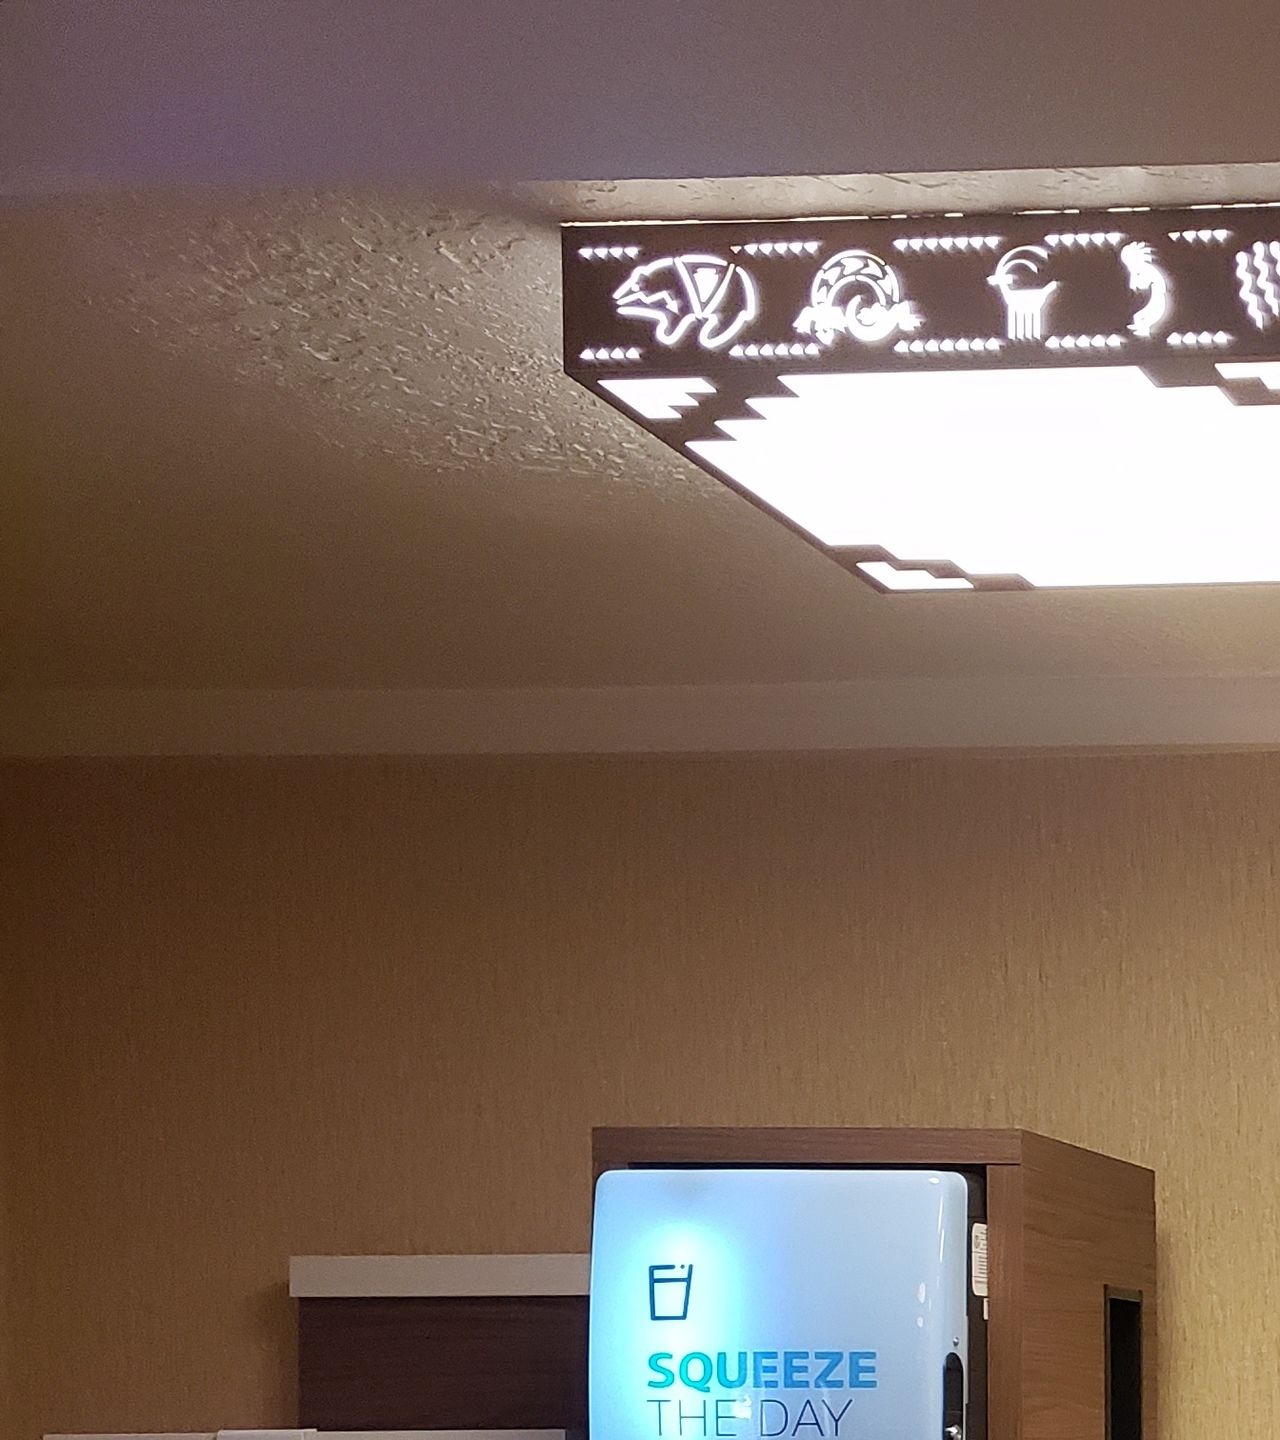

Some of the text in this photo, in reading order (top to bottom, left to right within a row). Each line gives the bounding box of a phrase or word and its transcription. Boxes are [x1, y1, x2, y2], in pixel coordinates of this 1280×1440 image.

[647, 1351, 878, 1393] SQUEEZE
[646, 1399, 854, 1437] THE DAY
